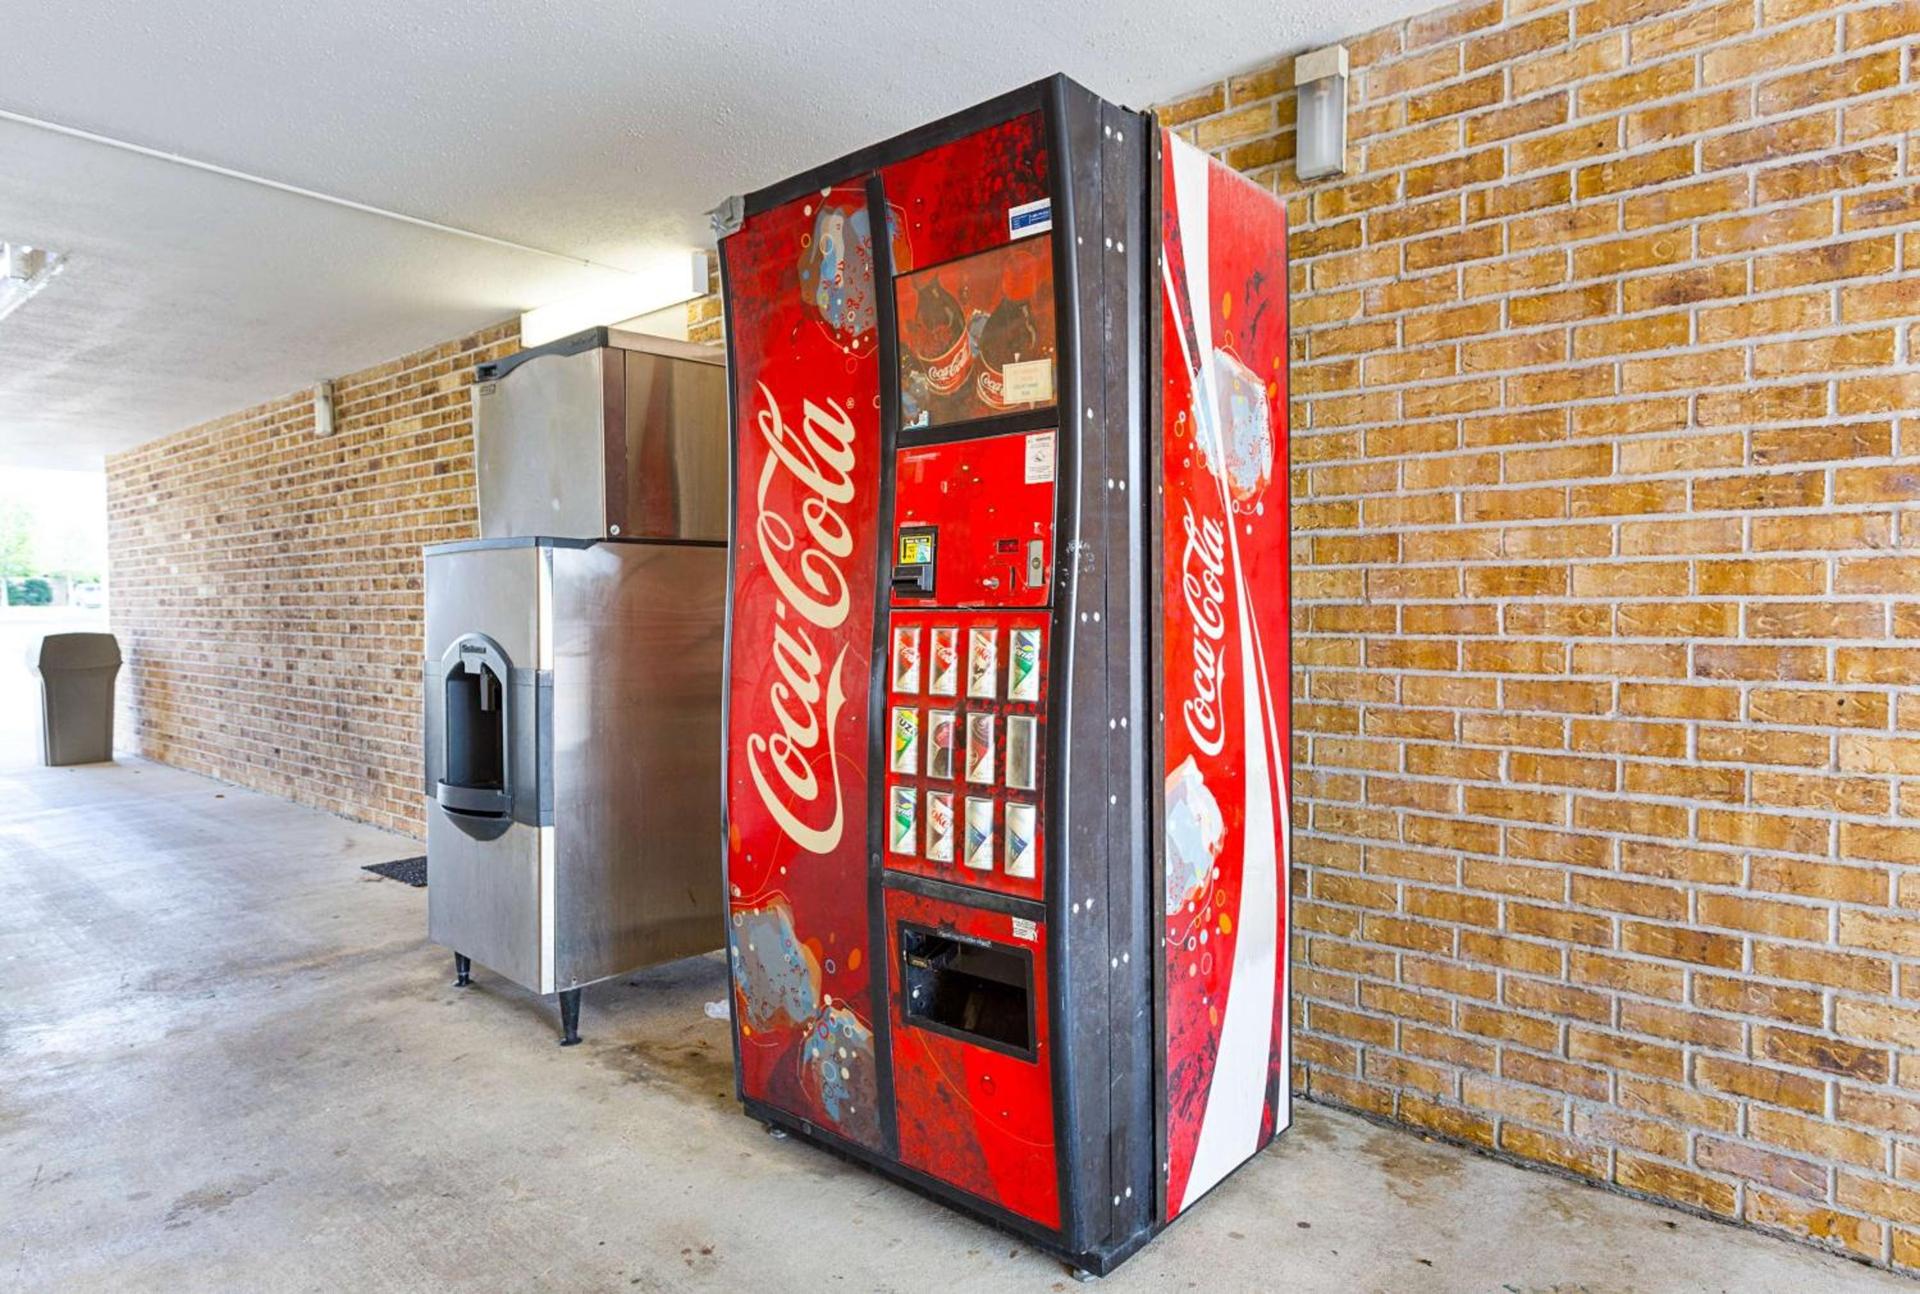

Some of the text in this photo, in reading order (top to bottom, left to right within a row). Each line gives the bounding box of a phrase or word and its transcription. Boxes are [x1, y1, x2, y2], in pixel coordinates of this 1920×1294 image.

[928, 344, 967, 381] Coca-Cola
[746, 379, 856, 855] Coca-Cola
[1183, 497, 1225, 756] Coca-Cola
